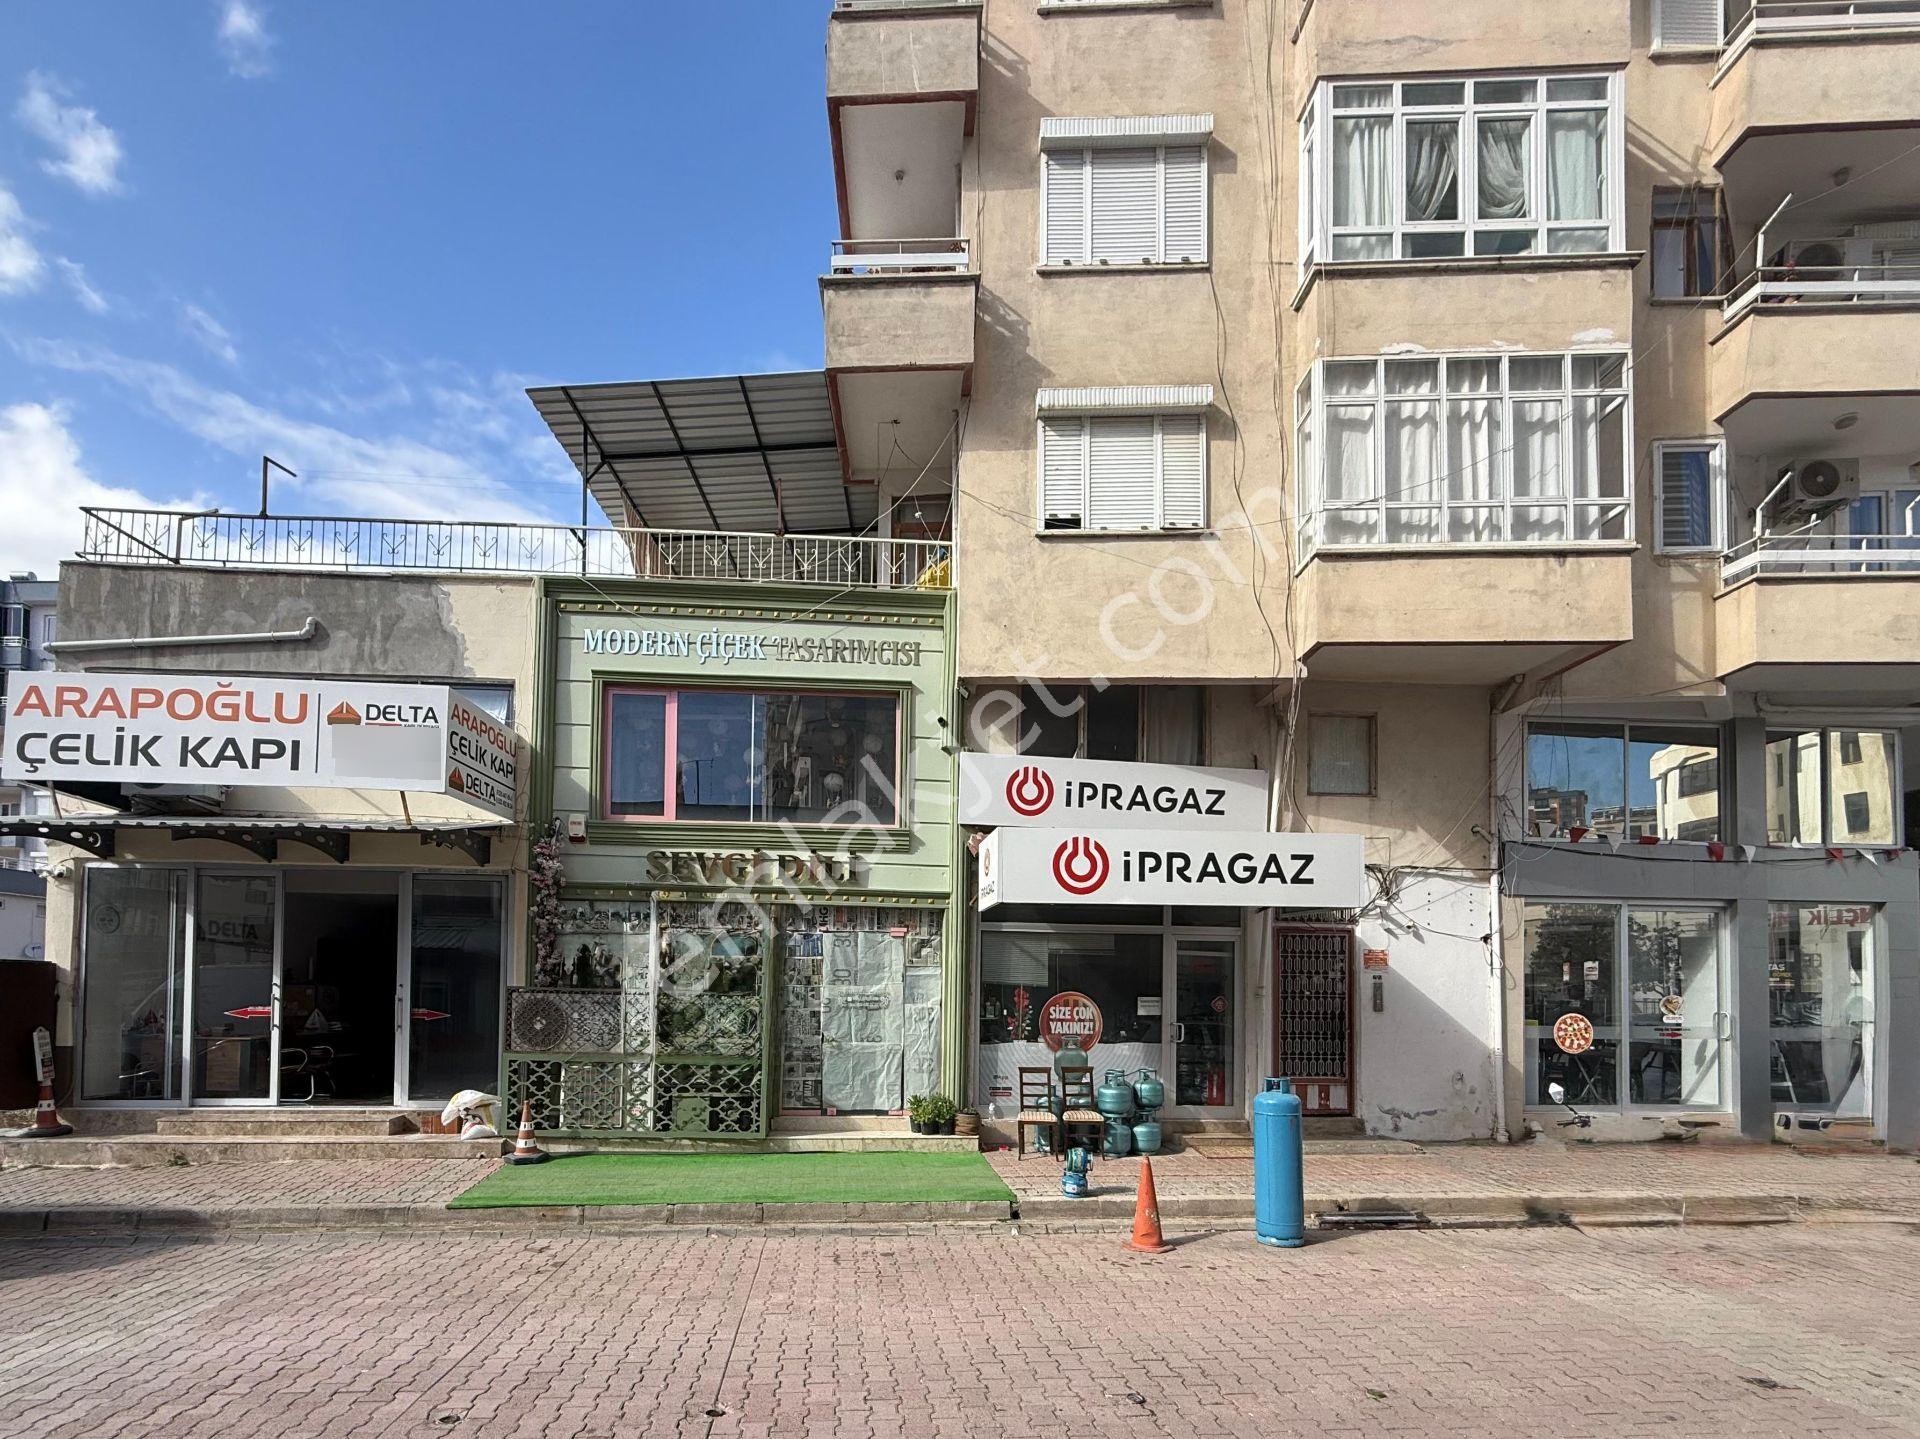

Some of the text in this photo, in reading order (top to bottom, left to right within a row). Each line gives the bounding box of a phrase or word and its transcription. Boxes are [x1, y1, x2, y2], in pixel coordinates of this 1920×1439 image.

[582, 627, 922, 668] MODERN ÇİÇEK TASARIMCISI
[13, 681, 309, 725] ARAPOĞLU
[365, 703, 439, 724] DELTA
[16, 726, 301, 773] ÇELİK KAPI
[450, 703, 517, 759] ARAPOĞLU
[449, 730, 516, 783] ÇELİK KAPI
[465, 772, 496, 802] DELTA
[646, 847, 862, 884] SEVGİ DİLİ
[207, 919, 258, 940] DELTA
[1049, 1004, 1094, 1021] SİZE ÇOK
[1049, 1021, 1094, 1035] YAKINIZ!
